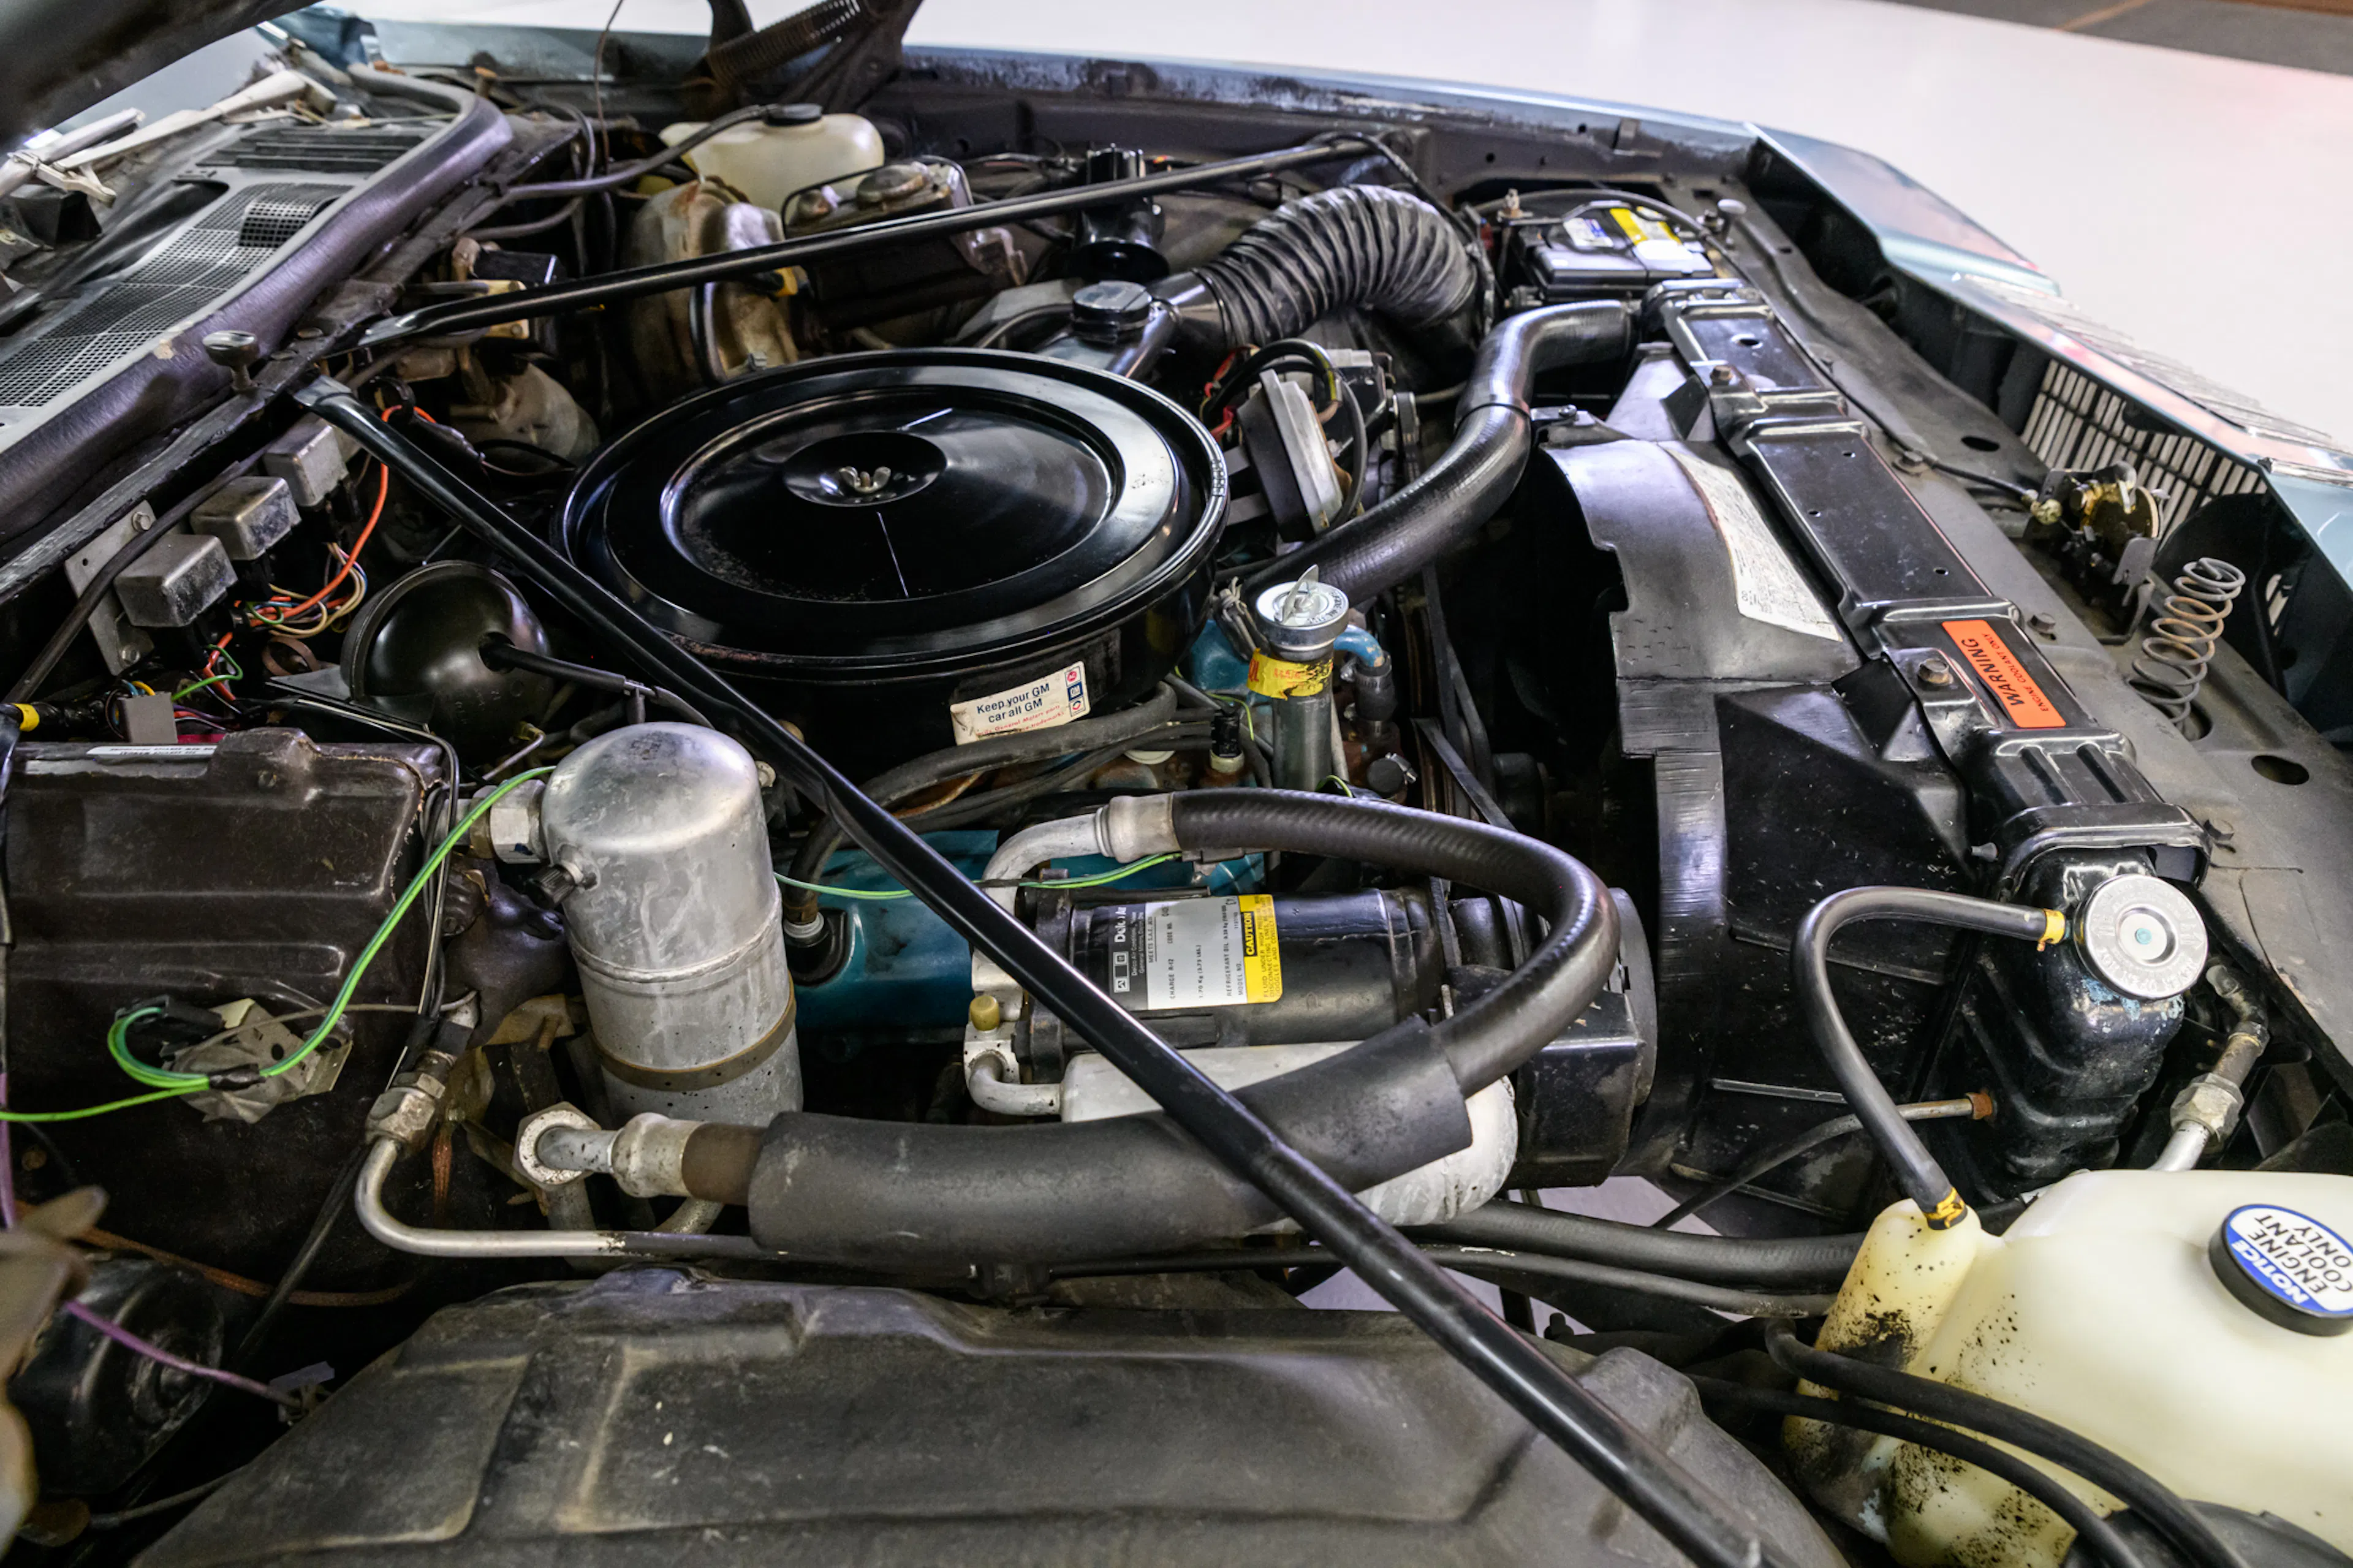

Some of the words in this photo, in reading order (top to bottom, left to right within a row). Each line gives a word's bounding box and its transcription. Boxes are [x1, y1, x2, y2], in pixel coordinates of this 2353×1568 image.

[1982, 634, 2000, 649] ONLY
[1961, 638, 2025, 706] WARNING
[1996, 651, 2026, 683] COOLANT
[977, 700, 1006, 714] Keep
[1008, 692, 1029, 705] your
[1032, 683, 1050, 696] GM
[988, 713, 1006, 723] car
[1009, 707, 1023, 719] all
[1025, 698, 1043, 712] GM
[2023, 686, 2049, 711] ENGINE
[1244, 913, 1254, 955] CAUTION
[1265, 943, 1275, 998] DISCONNECTING
[2248, 1228, 2328, 1293] ENGINE
[2255, 1215, 2353, 1292] COOLANT
[2294, 1226, 2352, 1268] ONLY
[2231, 1239, 2309, 1304] NOTICE
